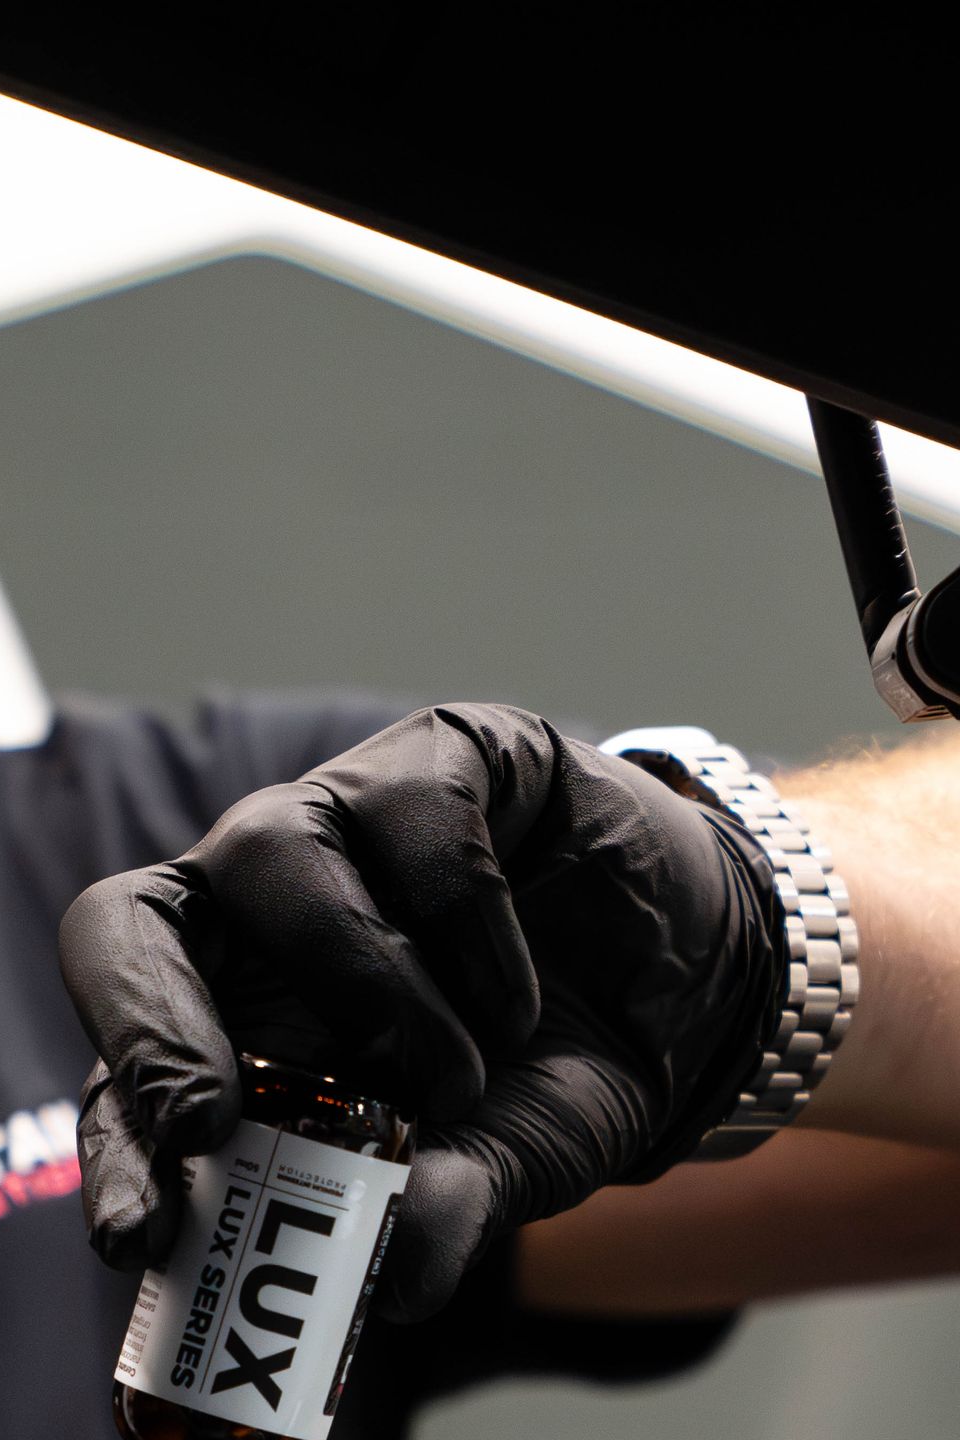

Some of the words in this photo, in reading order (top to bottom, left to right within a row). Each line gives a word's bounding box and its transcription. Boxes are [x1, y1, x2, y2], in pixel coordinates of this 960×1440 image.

[207, 1184, 252, 1260] LUX
[170, 1263, 226, 1390] SERIES
[210, 1198, 337, 1414] LUX
